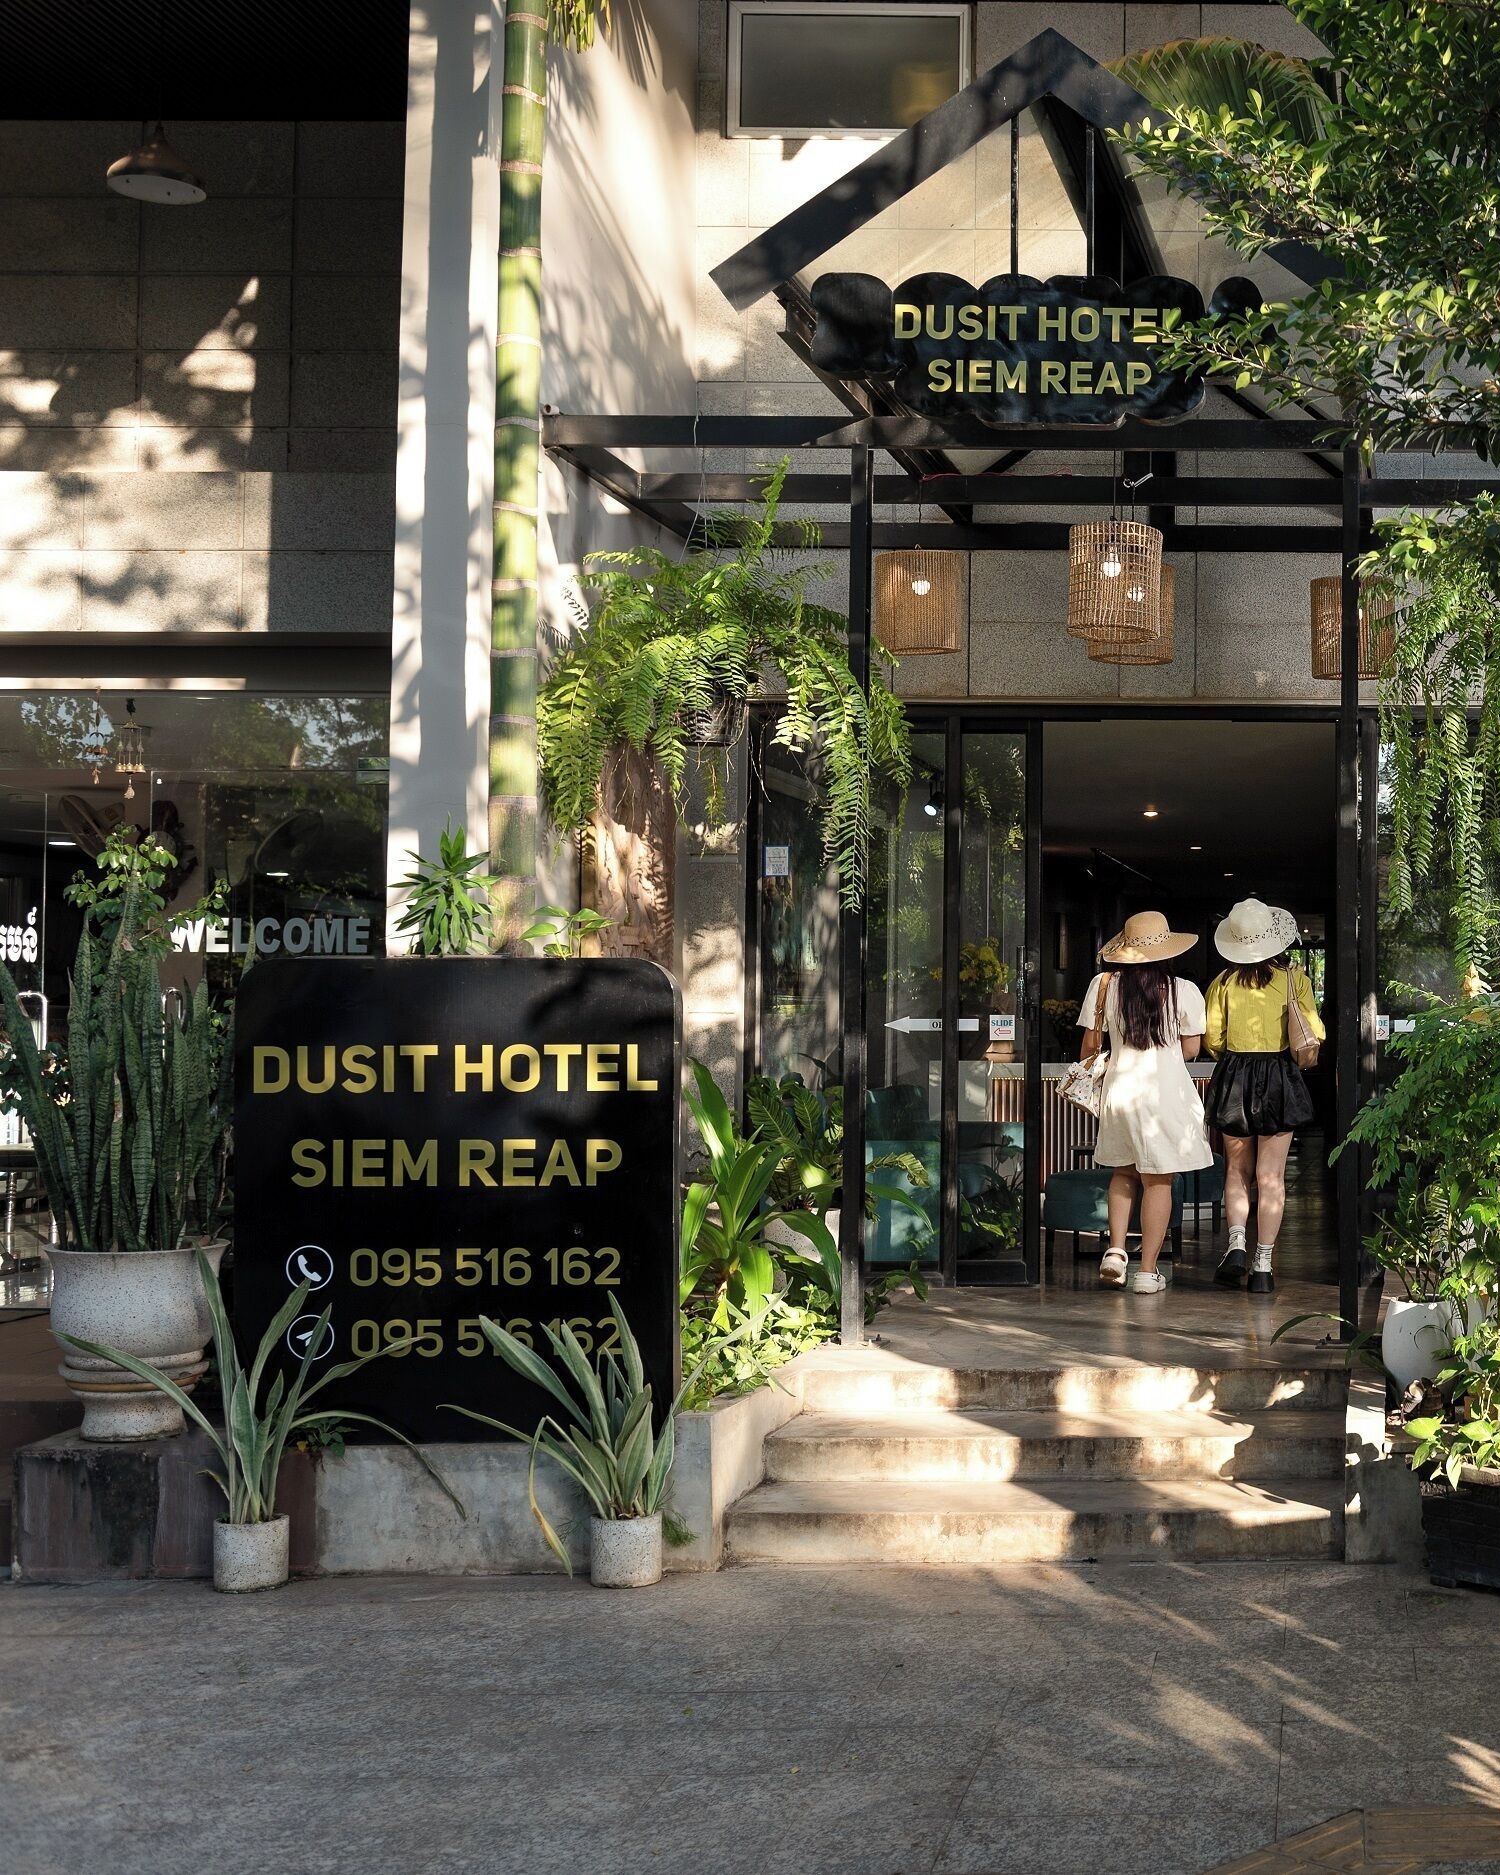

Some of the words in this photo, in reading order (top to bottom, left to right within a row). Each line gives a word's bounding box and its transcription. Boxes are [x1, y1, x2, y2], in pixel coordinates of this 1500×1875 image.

[894, 303, 1026, 341] DUSIT
[927, 359, 1027, 393] SIEM
[1040, 361, 1151, 395] REAP
[168, 917, 371, 953] WELCOME
[991, 1019, 1014, 1027] SLIDE
[252, 1045, 438, 1094] DUSIT
[454, 1043, 658, 1092] HOTEL
[290, 1139, 438, 1187] SIEM
[457, 1139, 623, 1187] REAP
[349, 1248, 442, 1287] 095
[455, 1247, 532, 1286] 516
[543, 1247, 621, 1285] 162
[351, 1319, 444, 1358] 095
